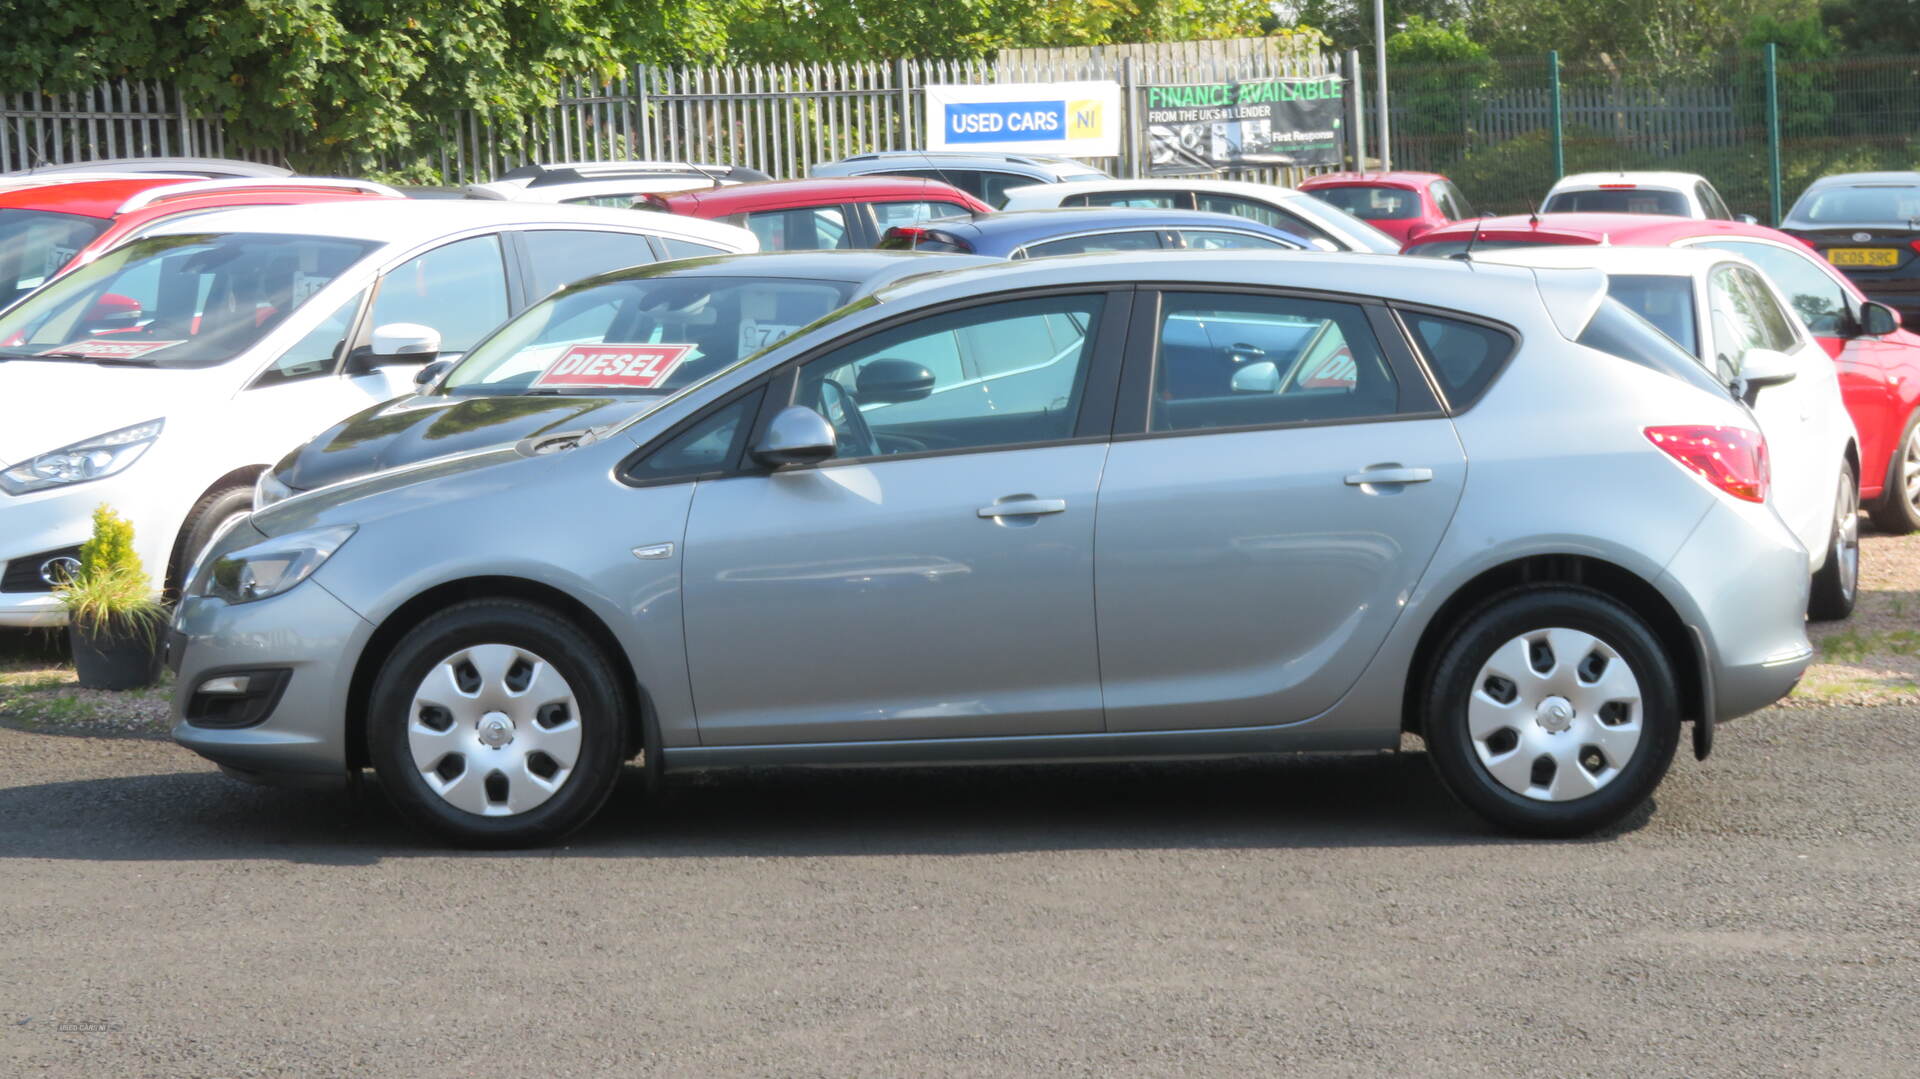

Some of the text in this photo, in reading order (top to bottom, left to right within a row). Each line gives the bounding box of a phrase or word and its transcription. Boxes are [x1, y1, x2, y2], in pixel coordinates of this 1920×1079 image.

[1150, 80, 1342, 108] FINANCE AVAILABLE
[952, 110, 1095, 133] USED CARS NI
[1149, 111, 1177, 123] FROM
[1179, 110, 1199, 122] THE
[1235, 105, 1271, 119] LENDER
[1272, 132, 1292, 142] First
[551, 354, 665, 378] DIESEL
